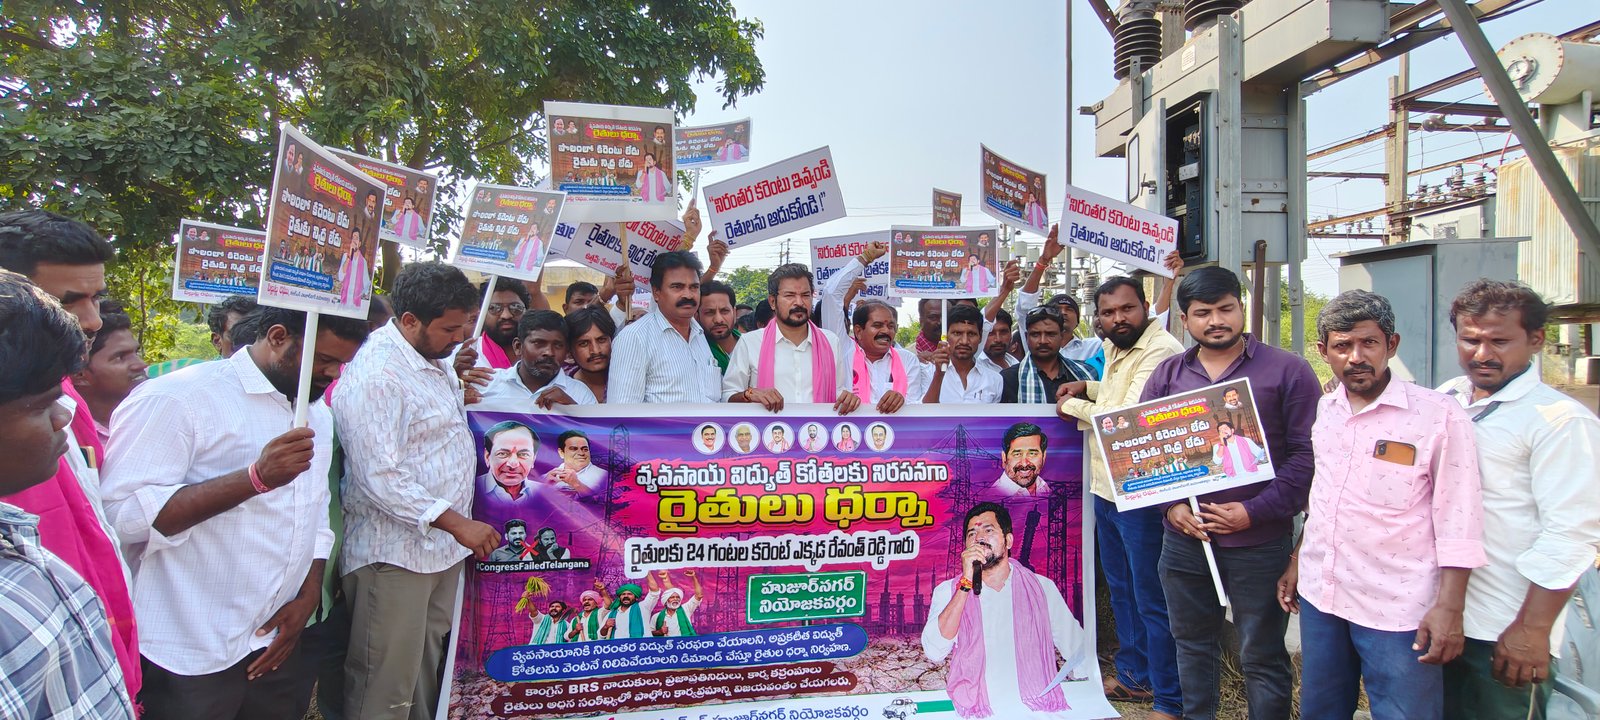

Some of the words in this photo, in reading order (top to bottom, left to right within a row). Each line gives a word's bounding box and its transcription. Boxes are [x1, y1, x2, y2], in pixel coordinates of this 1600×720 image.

[558, 143, 594, 153] పొలంలో
[596, 145, 622, 155] కరెంటు
[625, 144, 640, 156] లేదు
[573, 157, 598, 169] రైతుకు
[600, 158, 615, 169] నిద్ర
[618, 157, 633, 169] లేదు
[753, 176, 791, 201] కరెంటు
[791, 158, 831, 189] ఇవ్వండి
[281, 188, 311, 211] పొలంలో
[312, 201, 335, 224] కరెంటు
[337, 210, 350, 229] లేదు
[725, 213, 767, 245] రైతులను
[767, 194, 819, 228] ఆదుకోండి
[288, 215, 311, 237] రైతుకు
[312, 225, 327, 246] నిద్ర
[328, 228, 342, 248] లేదు
[1069, 222, 1109, 248] రైతులను
[1110, 236, 1156, 263] ఆదుకోండి
[1108, 209, 1141, 232] కరెంటు
[1141, 221, 1175, 244] ఇవ్వండి
[1146, 410, 1179, 426] రైతులు
[1111, 434, 1153, 451] పొలంలో
[1155, 426, 1188, 441] కరెంటు
[1190, 420, 1210, 433] లేదు
[1130, 446, 1161, 464] రైతుకు
[1163, 441, 1183, 454] నిద్ర
[1185, 436, 1205, 449] లేదు
[636, 461, 726, 493] వ్యవసాయ
[731, 459, 791, 491] విద్యుత్
[795, 458, 868, 485] కోతలకు
[872, 460, 948, 483] నిరసనగా
[657, 487, 815, 532] రైతులు
[824, 485, 935, 528] ధర్నా
[476, 561, 589, 573] #CongressFailedTelangana
[631, 543, 684, 572] రైతులకు
[686, 543, 705, 562] 24
[707, 540, 749, 561] గంటల
[752, 538, 792, 561] కరెంట్
[795, 540, 826, 567] ఎక్కడ
[828, 536, 867, 559] రేవంత్
[867, 537, 887, 565] రెడ్డి
[888, 535, 915, 556] గారు
[759, 595, 858, 615] నియోజకవర్గం
[512, 645, 591, 664] వ్యవసాయానికి
[593, 643, 637, 655] నిరంతర
[639, 639, 674, 654] విద్యుత్
[676, 639, 715, 651] సరఫరా
[768, 630, 811, 646] అప్రకటిత
[812, 626, 844, 642] విద్యుత్
[512, 663, 560, 677] కోతలను
[562, 658, 600, 674] వెంటనే
[602, 654, 679, 669] నిలిపివేయాలని
[680, 650, 723, 663] డిమాండ్
[725, 650, 752, 663] చేస్తూ
[754, 648, 784, 662] రైతుల
[785, 646, 810, 658] ధర్నా
[568, 682, 600, 695] BRS
[602, 676, 663, 691] నాయకులు,
[503, 701, 544, 715] రైతులు
